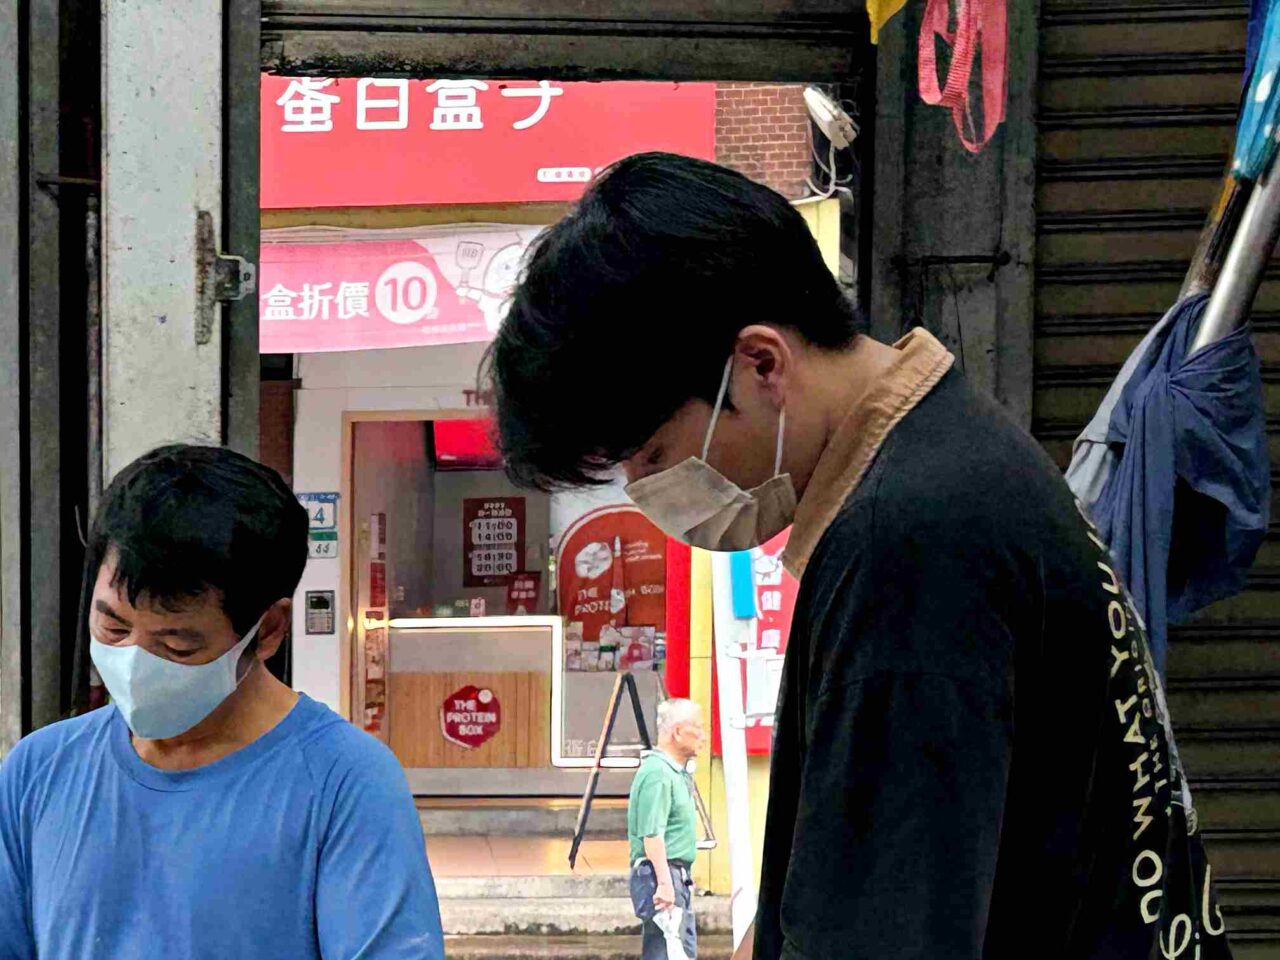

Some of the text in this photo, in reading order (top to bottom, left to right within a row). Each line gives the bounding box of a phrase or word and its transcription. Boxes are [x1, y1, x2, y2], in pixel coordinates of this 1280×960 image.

[383, 276, 427, 313] 10
[1097, 561, 1130, 678] YOU
[446, 711, 497, 723] PROTEIN
[454, 699, 477, 711] THE
[458, 724, 484, 736] BOX
[1115, 694, 1154, 840] WHAT
